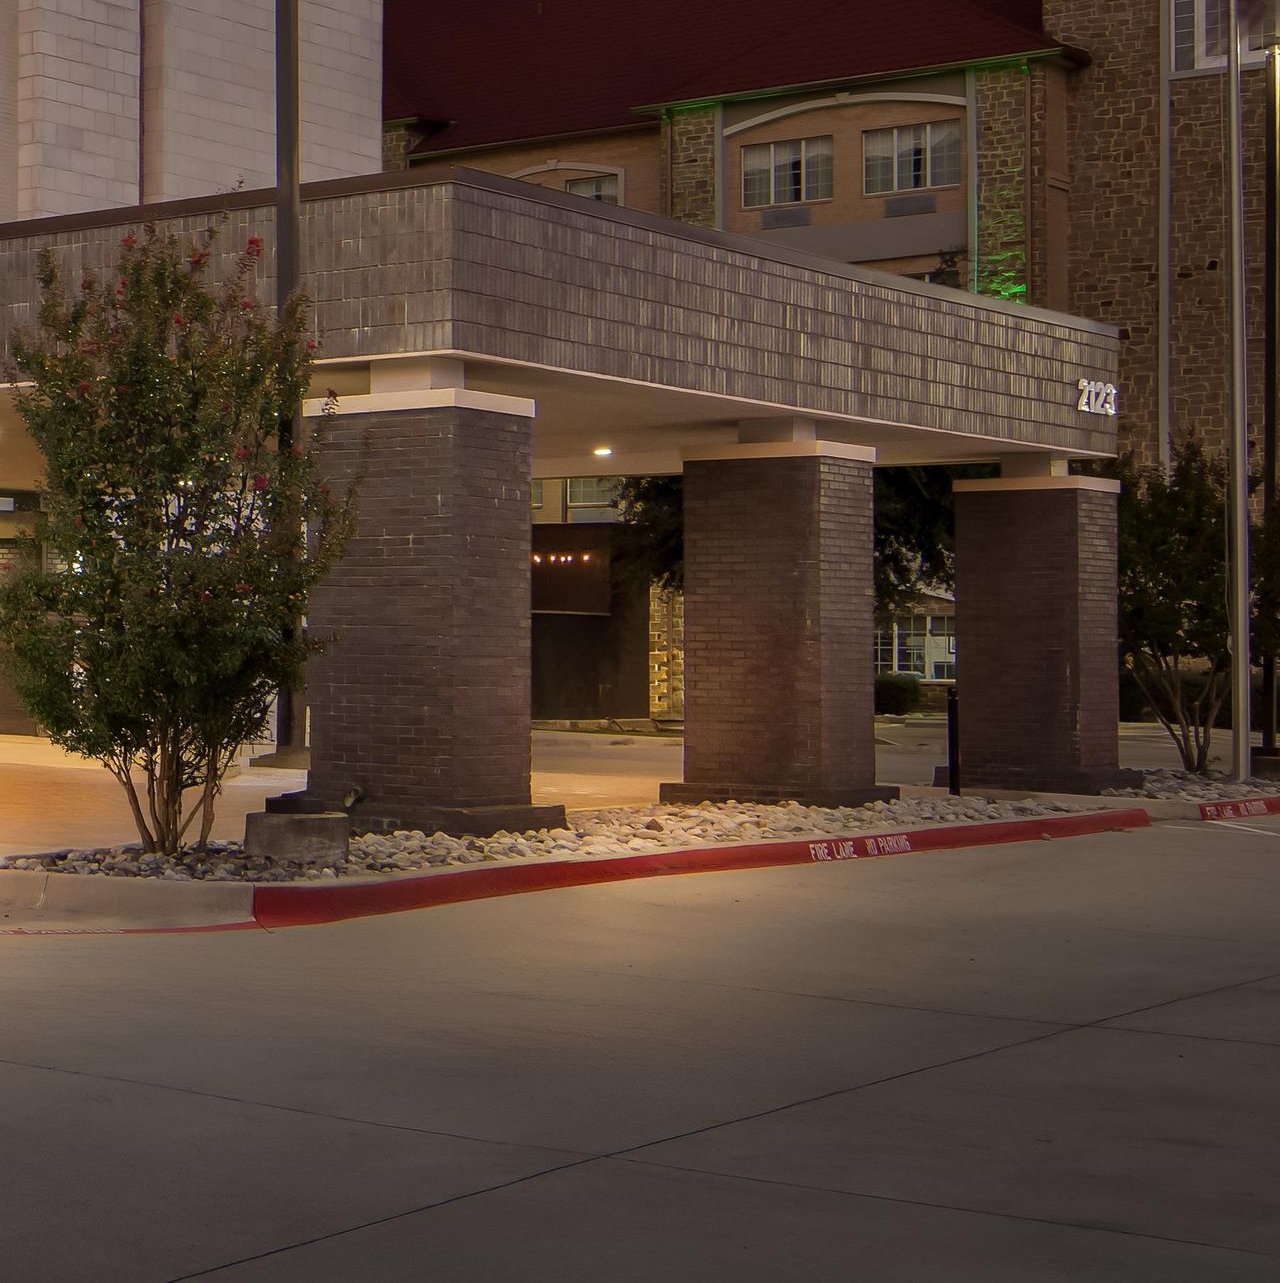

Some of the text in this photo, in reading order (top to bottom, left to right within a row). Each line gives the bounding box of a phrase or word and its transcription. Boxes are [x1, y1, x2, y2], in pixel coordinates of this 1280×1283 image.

[1077, 378, 1117, 416] 2123
[808, 835, 911, 860] FIRE LANE NO PARKING
